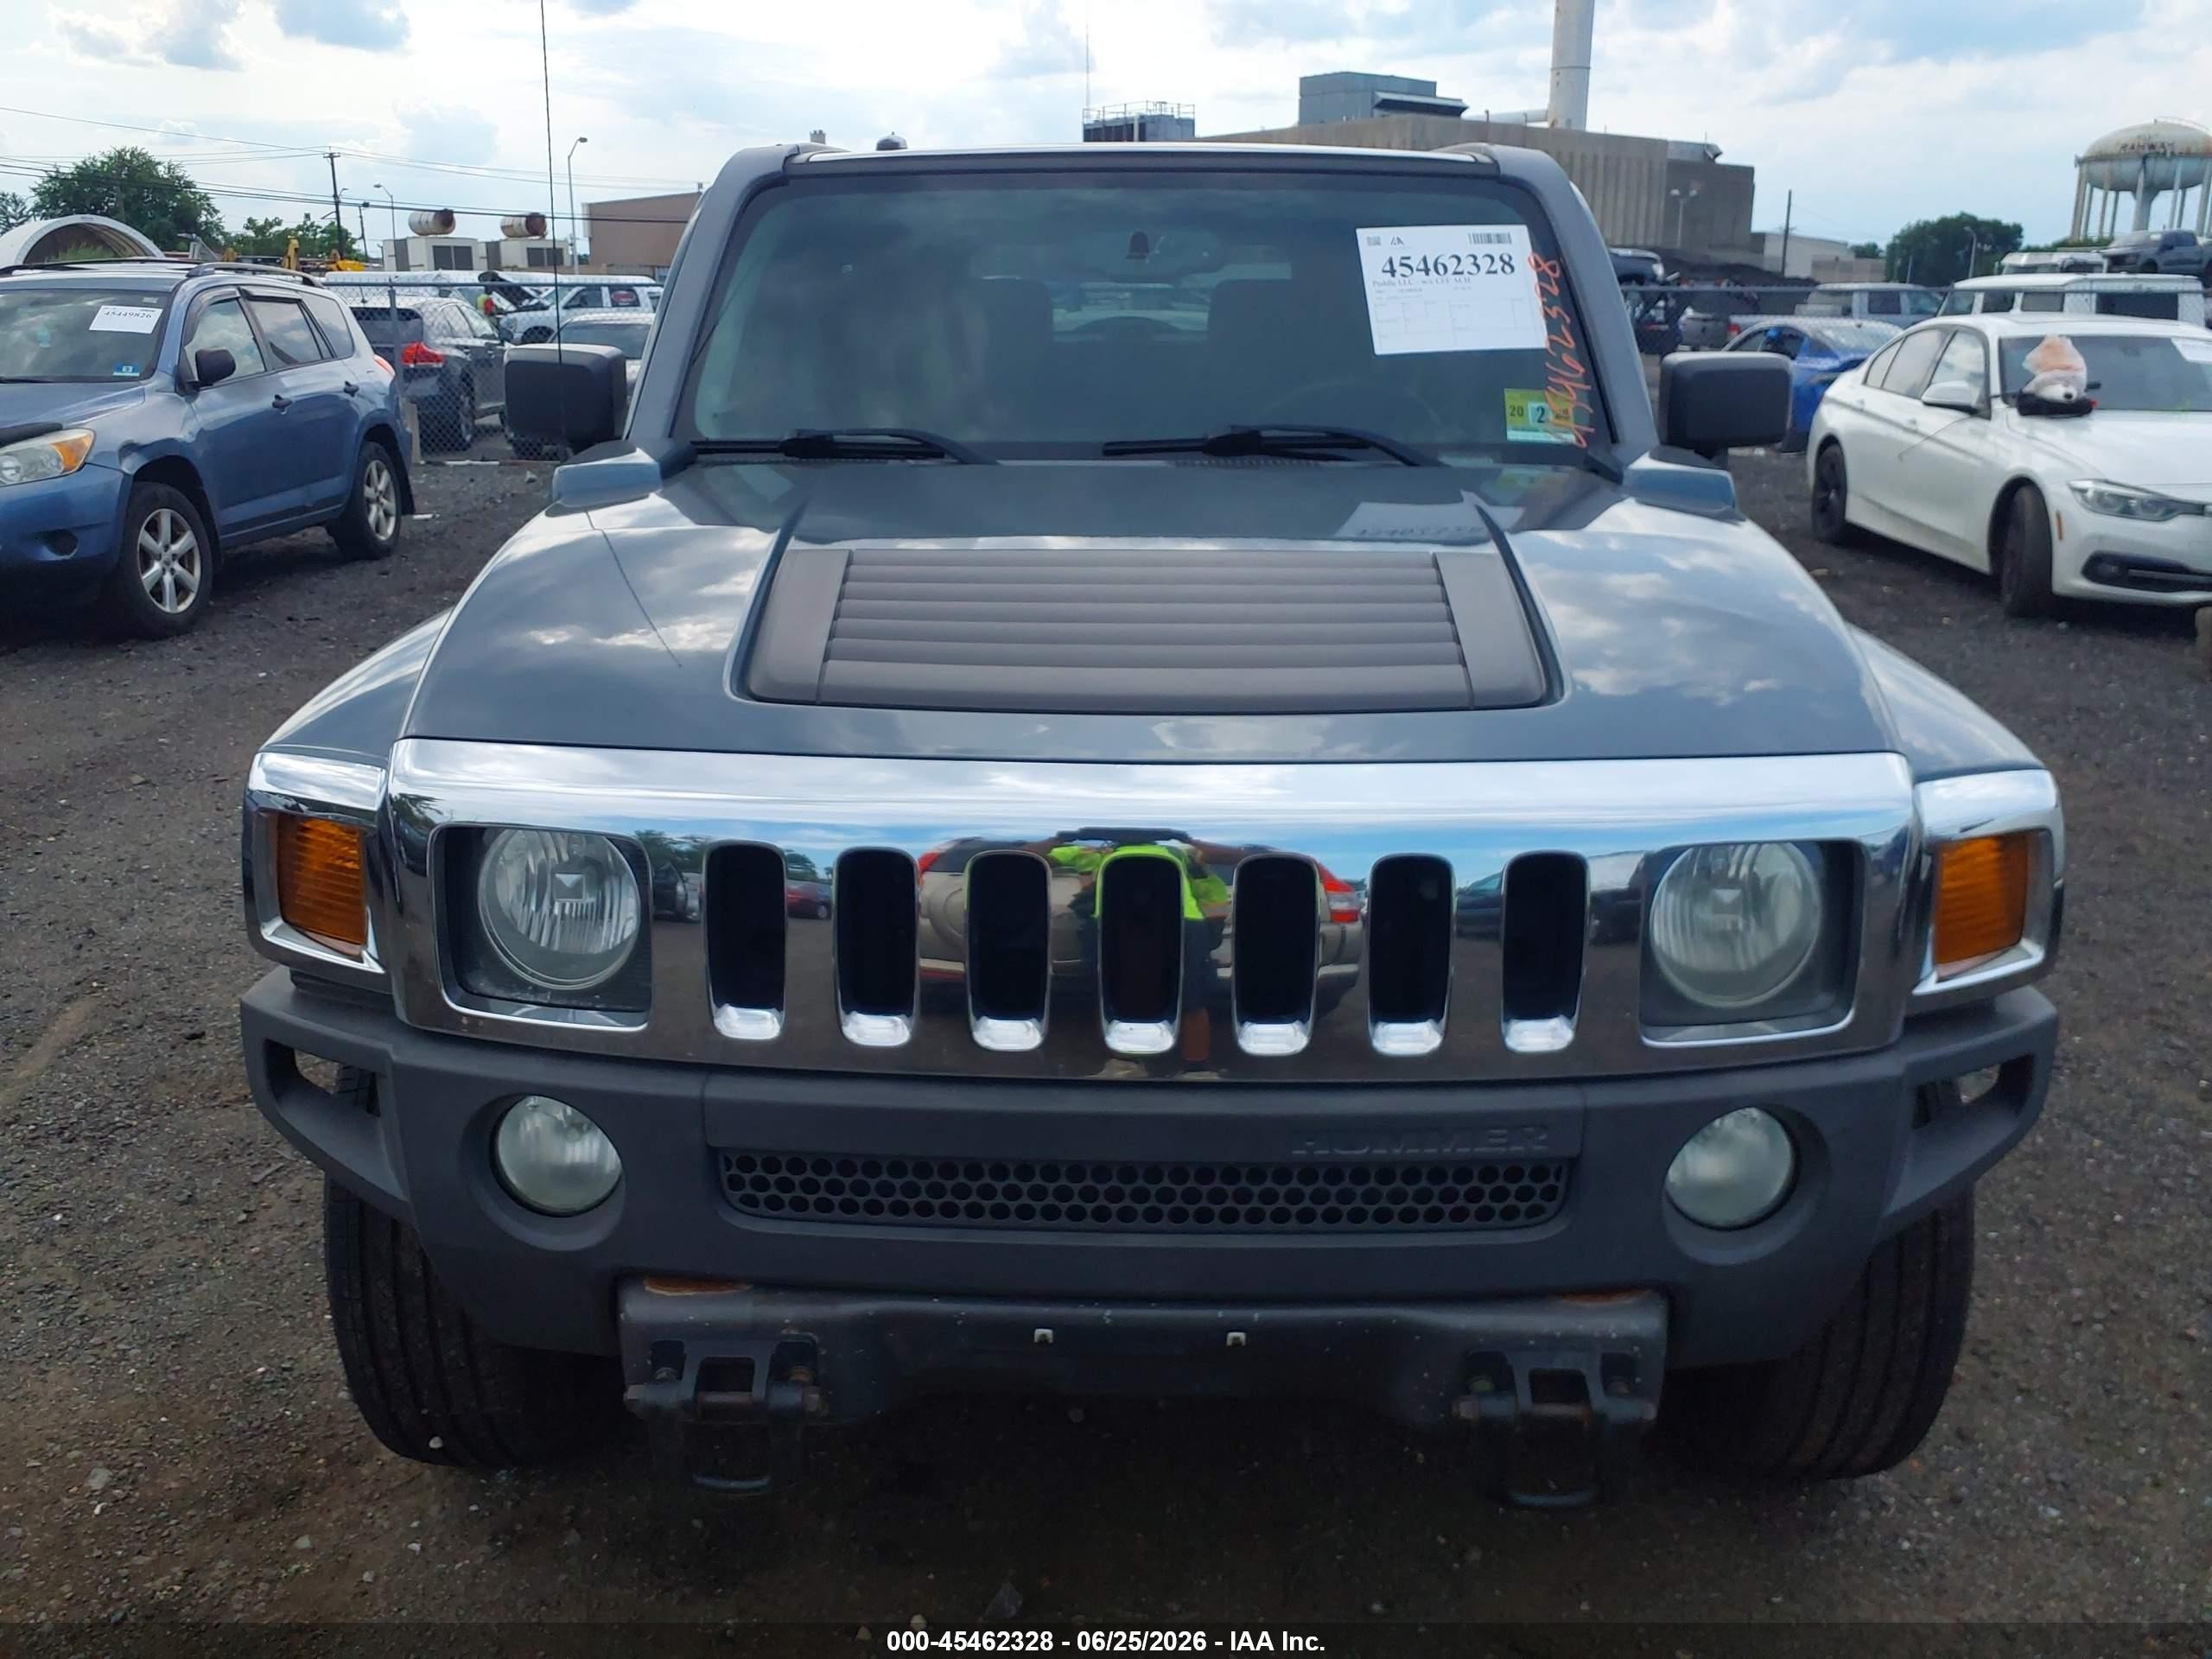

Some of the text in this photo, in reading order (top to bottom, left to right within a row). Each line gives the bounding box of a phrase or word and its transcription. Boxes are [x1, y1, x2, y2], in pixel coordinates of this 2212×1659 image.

[1382, 252, 1516, 278] 45462328
[1509, 404, 1524, 417] 20
[1536, 405, 1547, 423] 2
[1292, 1127, 1549, 1154] HUMMER
